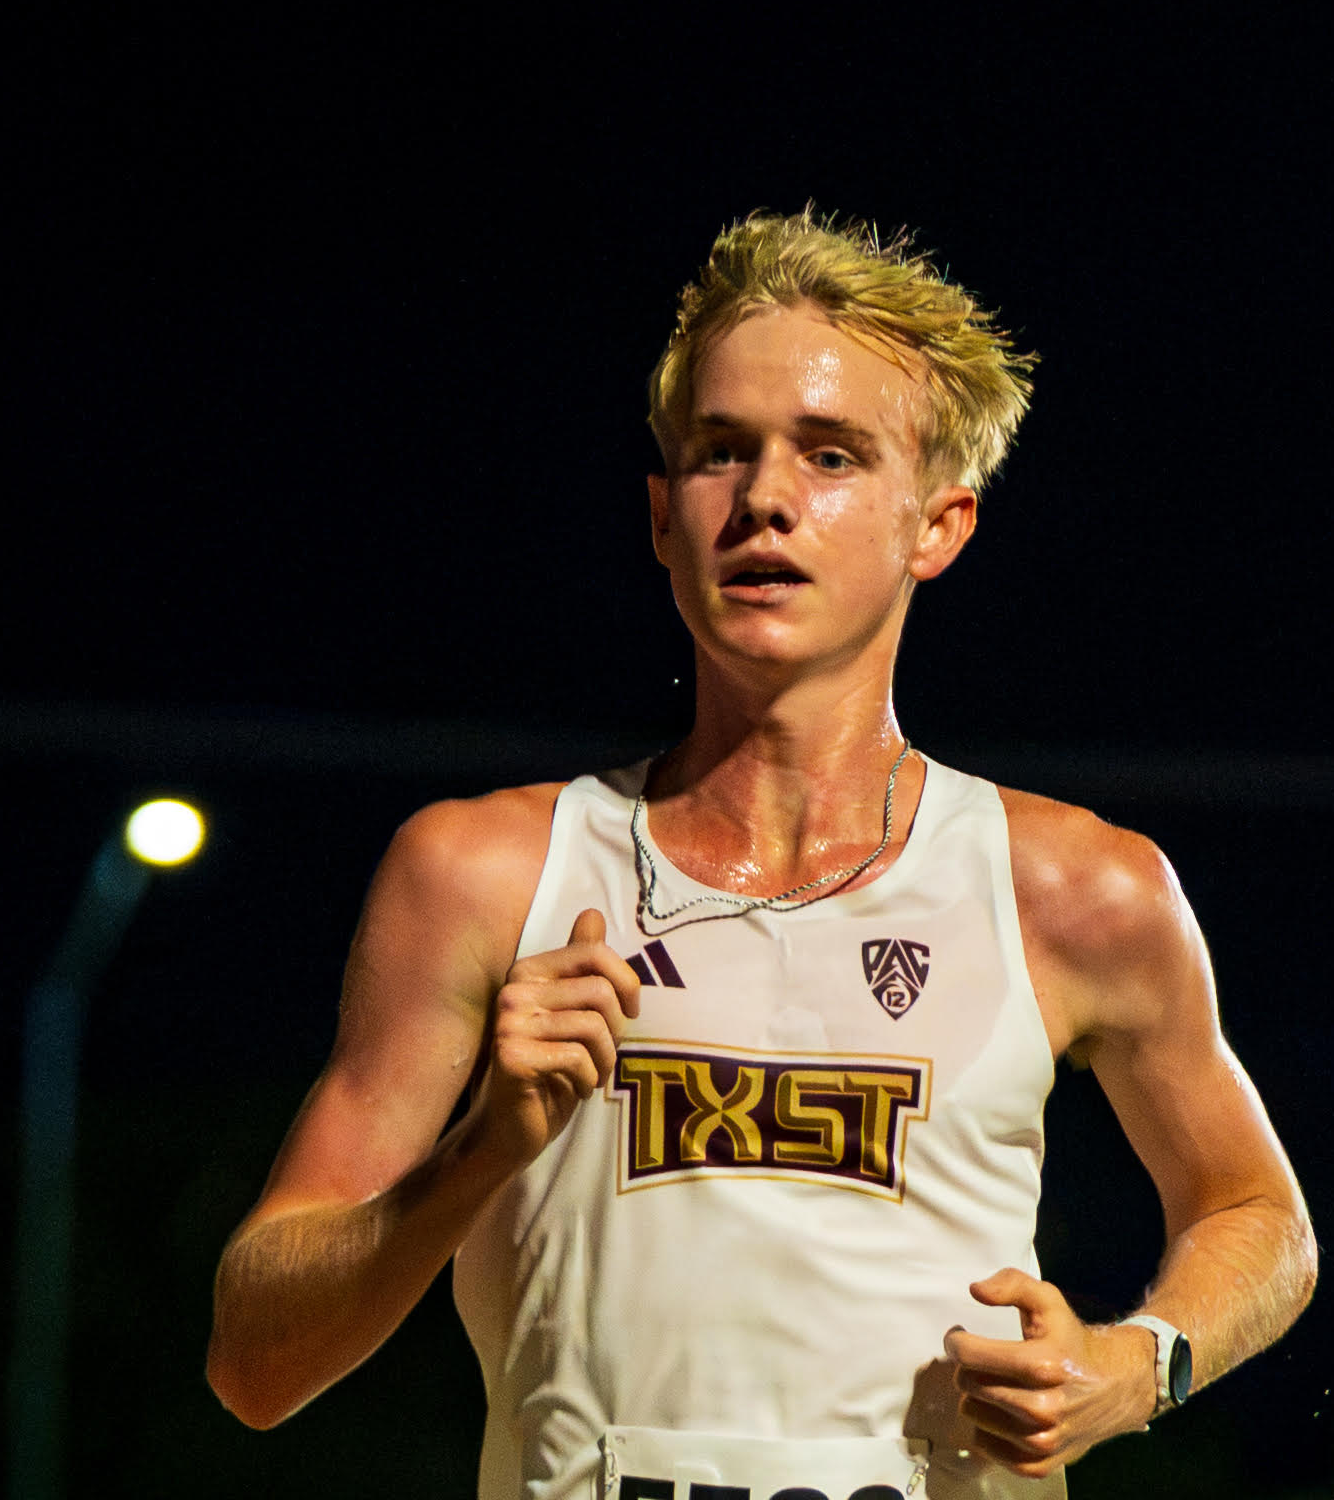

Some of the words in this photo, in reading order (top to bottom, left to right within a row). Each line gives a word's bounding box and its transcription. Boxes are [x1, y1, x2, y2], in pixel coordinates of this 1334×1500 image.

[862, 938, 930, 989] PAC
[886, 990, 906, 1008] 12
[620, 1057, 913, 1180] TXST
